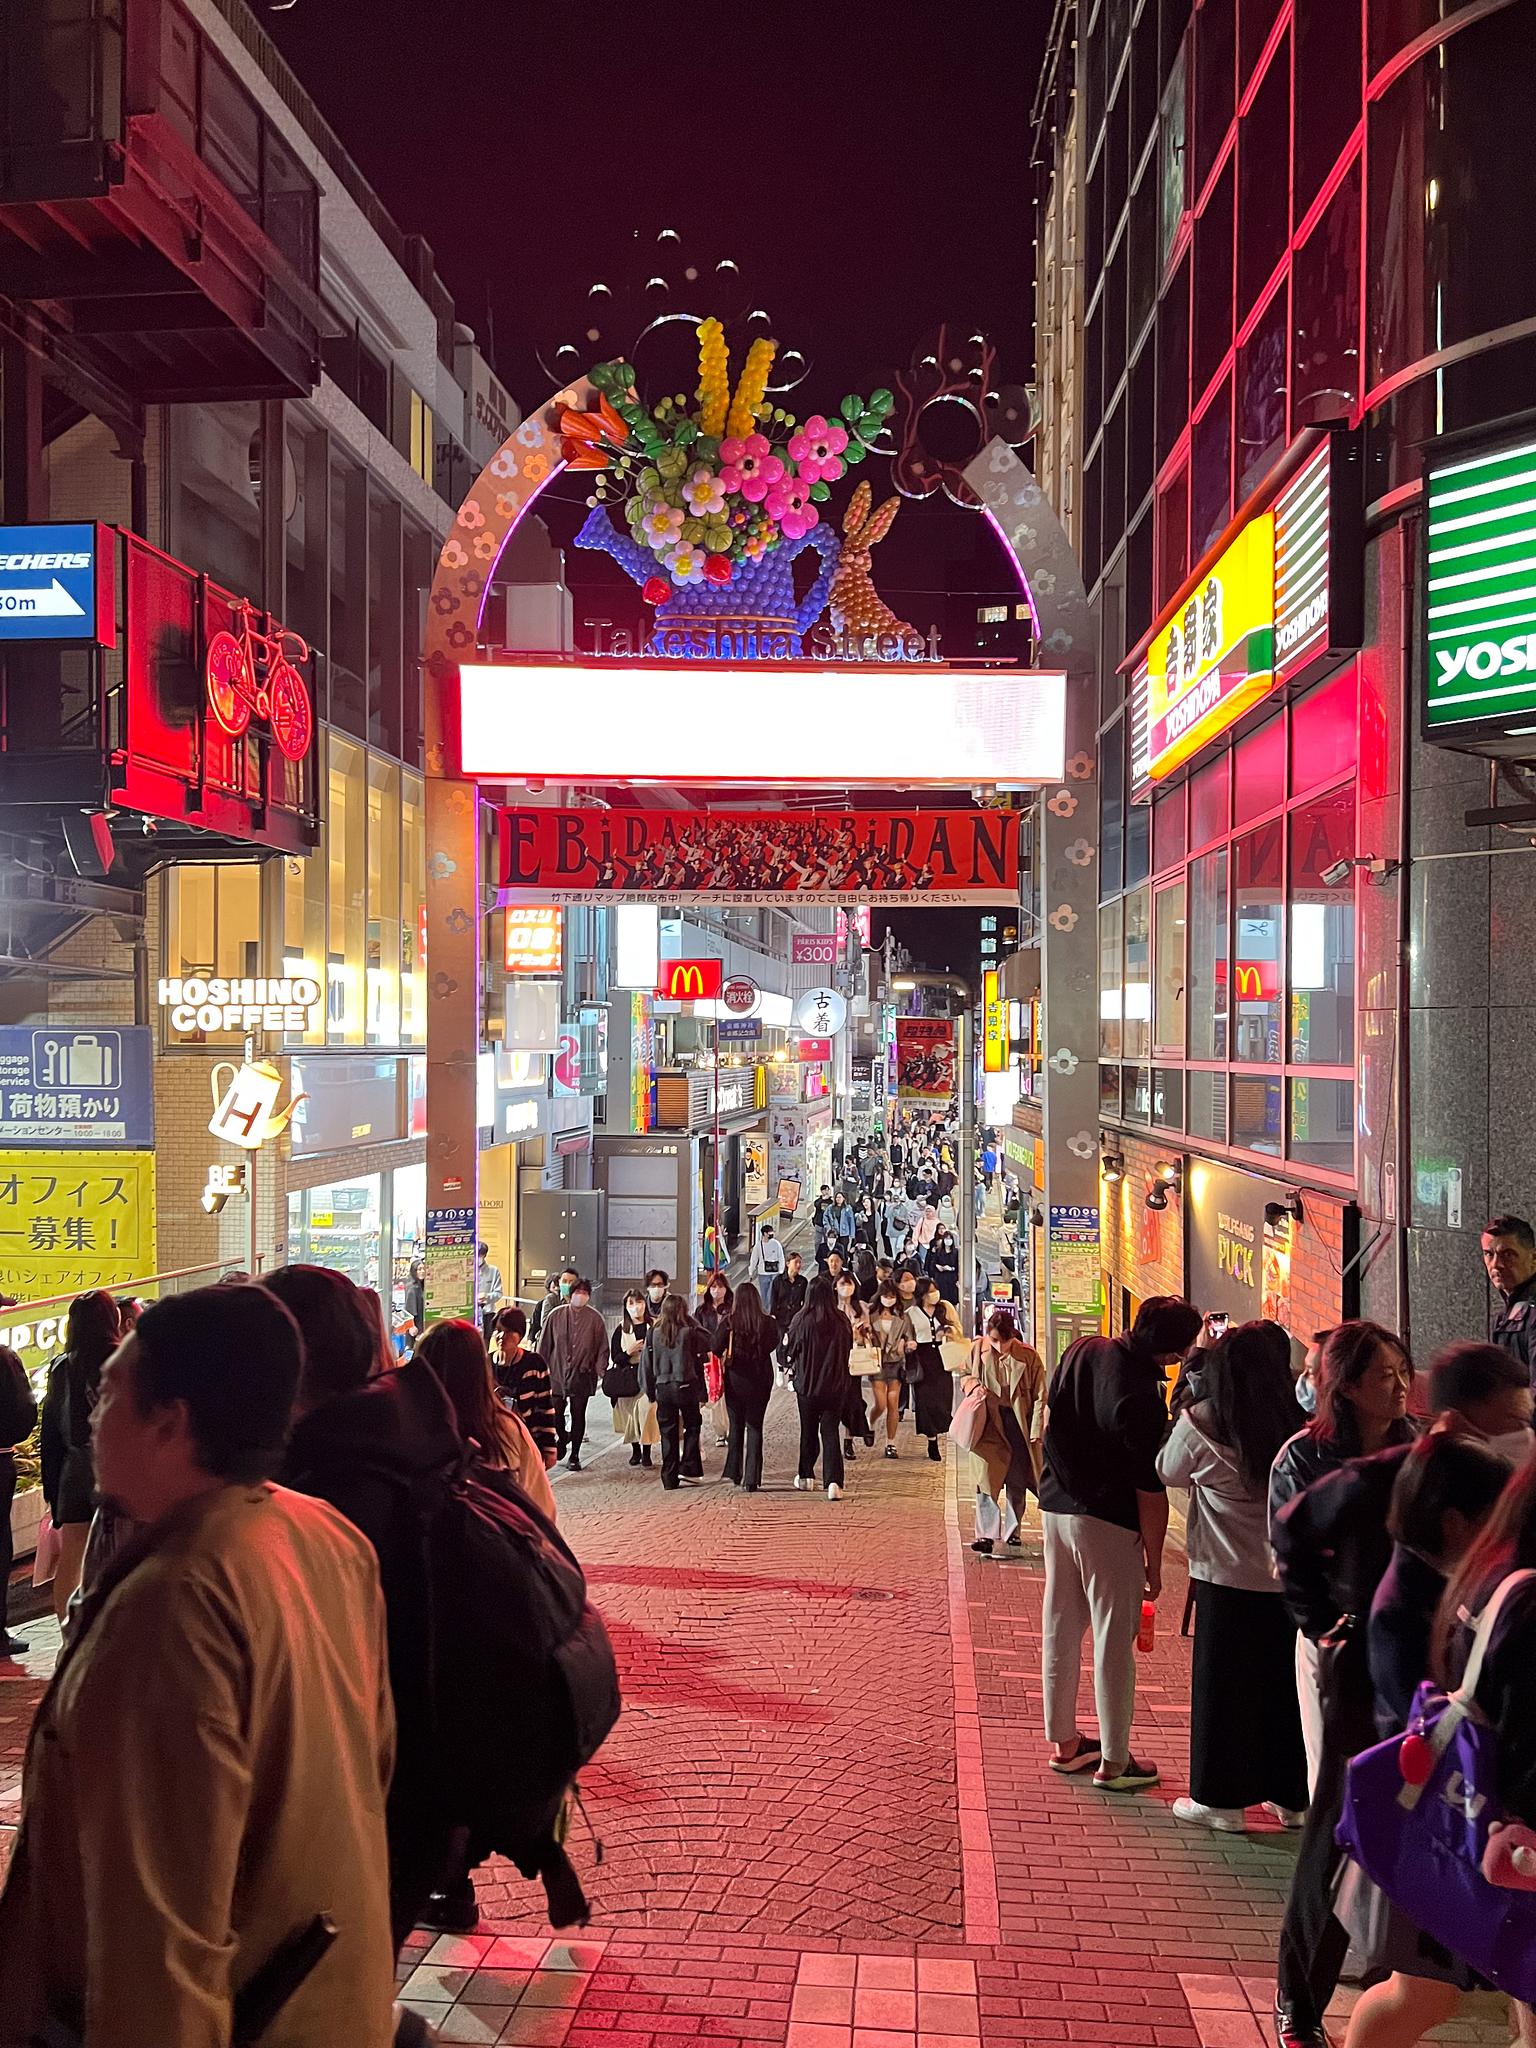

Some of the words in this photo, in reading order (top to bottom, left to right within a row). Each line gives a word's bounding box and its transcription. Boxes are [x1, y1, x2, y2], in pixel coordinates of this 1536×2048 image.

[584, 617, 793, 660] Takeshita
[811, 624, 944, 663] Street
[158, 978, 320, 1006] HOSHINO
[726, 991, 753, 1004] 消火栓
[171, 1004, 306, 1032] COFFEE
[813, 991, 831, 1032] 古着
[8, 1093, 120, 1118] 荷物預かり
[1218, 1234, 1254, 1287] PUCK
